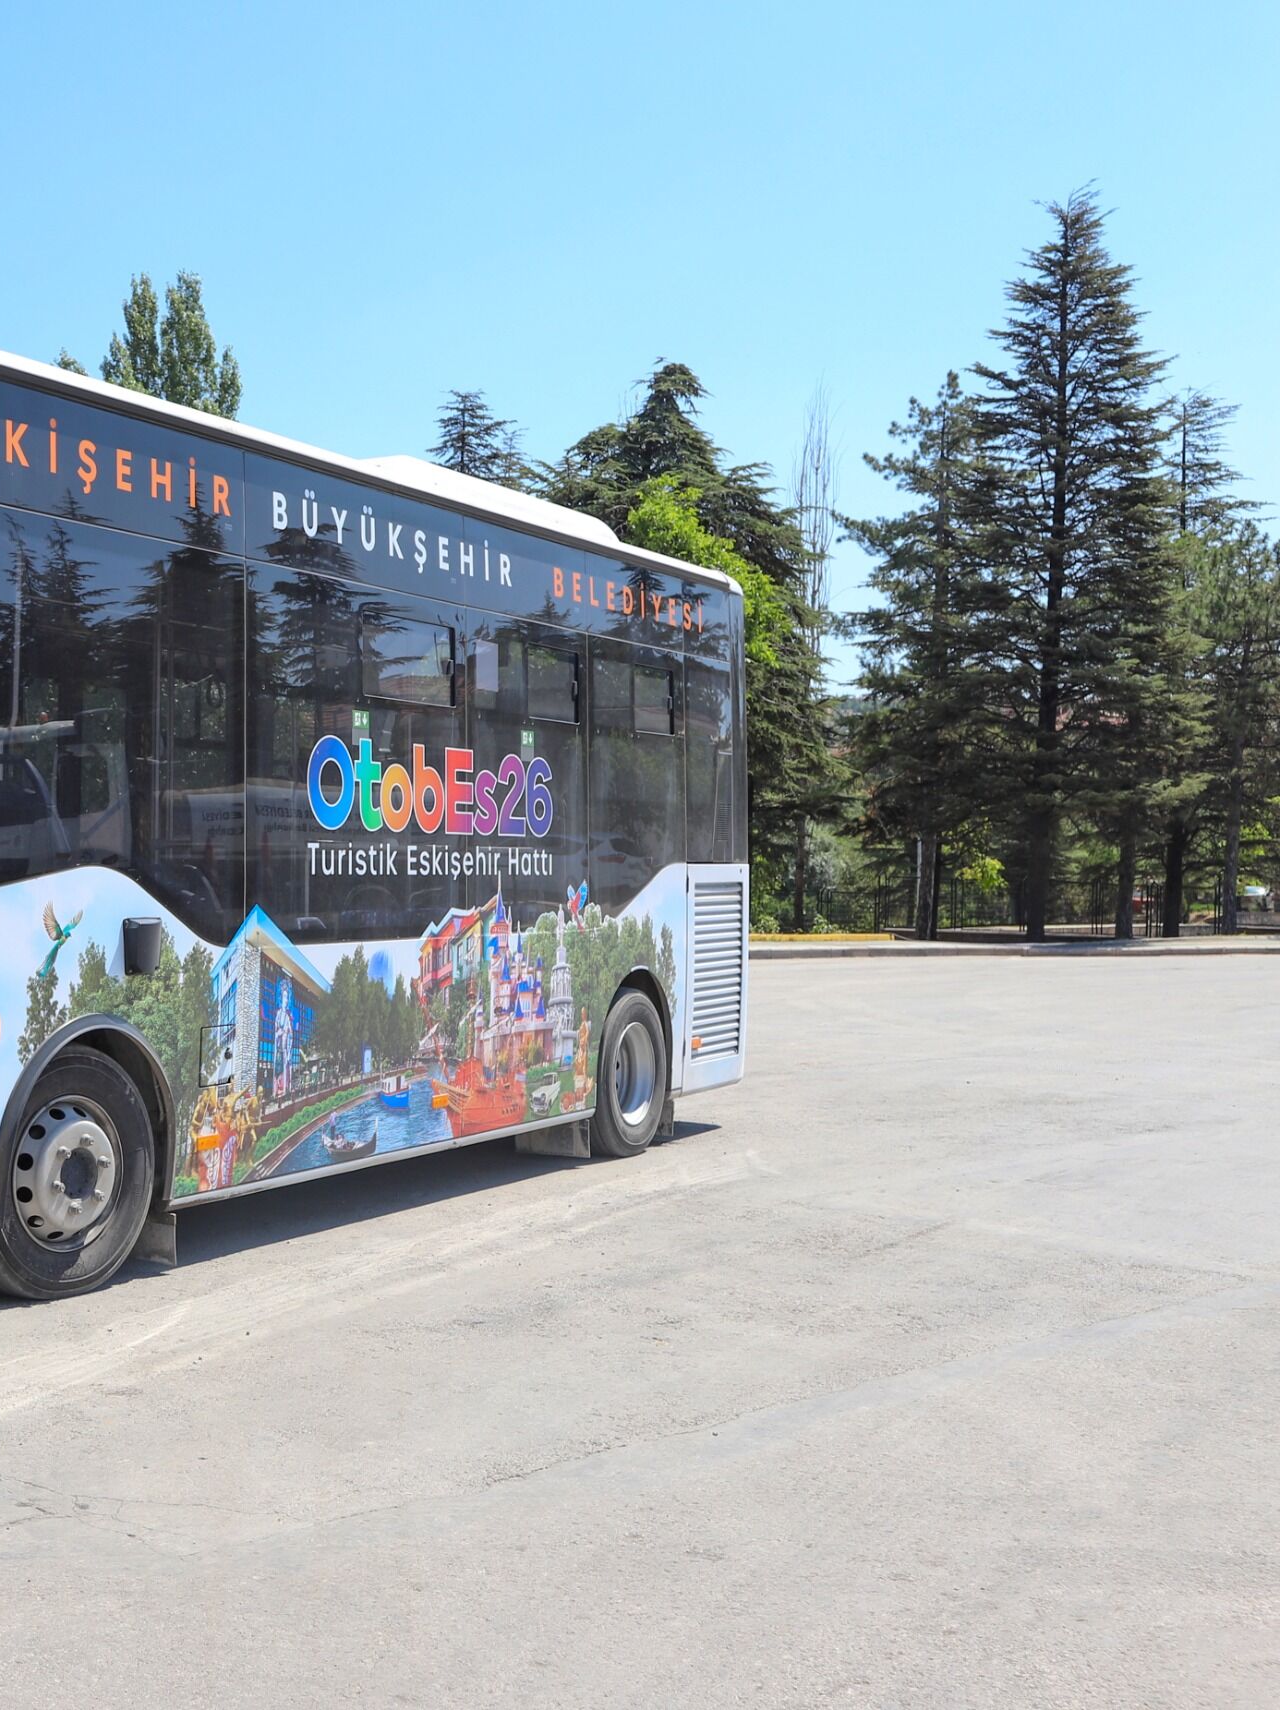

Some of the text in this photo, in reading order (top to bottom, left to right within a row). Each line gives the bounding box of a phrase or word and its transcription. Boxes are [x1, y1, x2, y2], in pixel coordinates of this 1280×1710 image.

[272, 491, 513, 588] BÜYÜKŞEHİR
[553, 566, 704, 634] BELEDİYESİ
[307, 735, 553, 837] OtobEs26
[307, 843, 553, 881] Turistik Eskişehir Hattı
